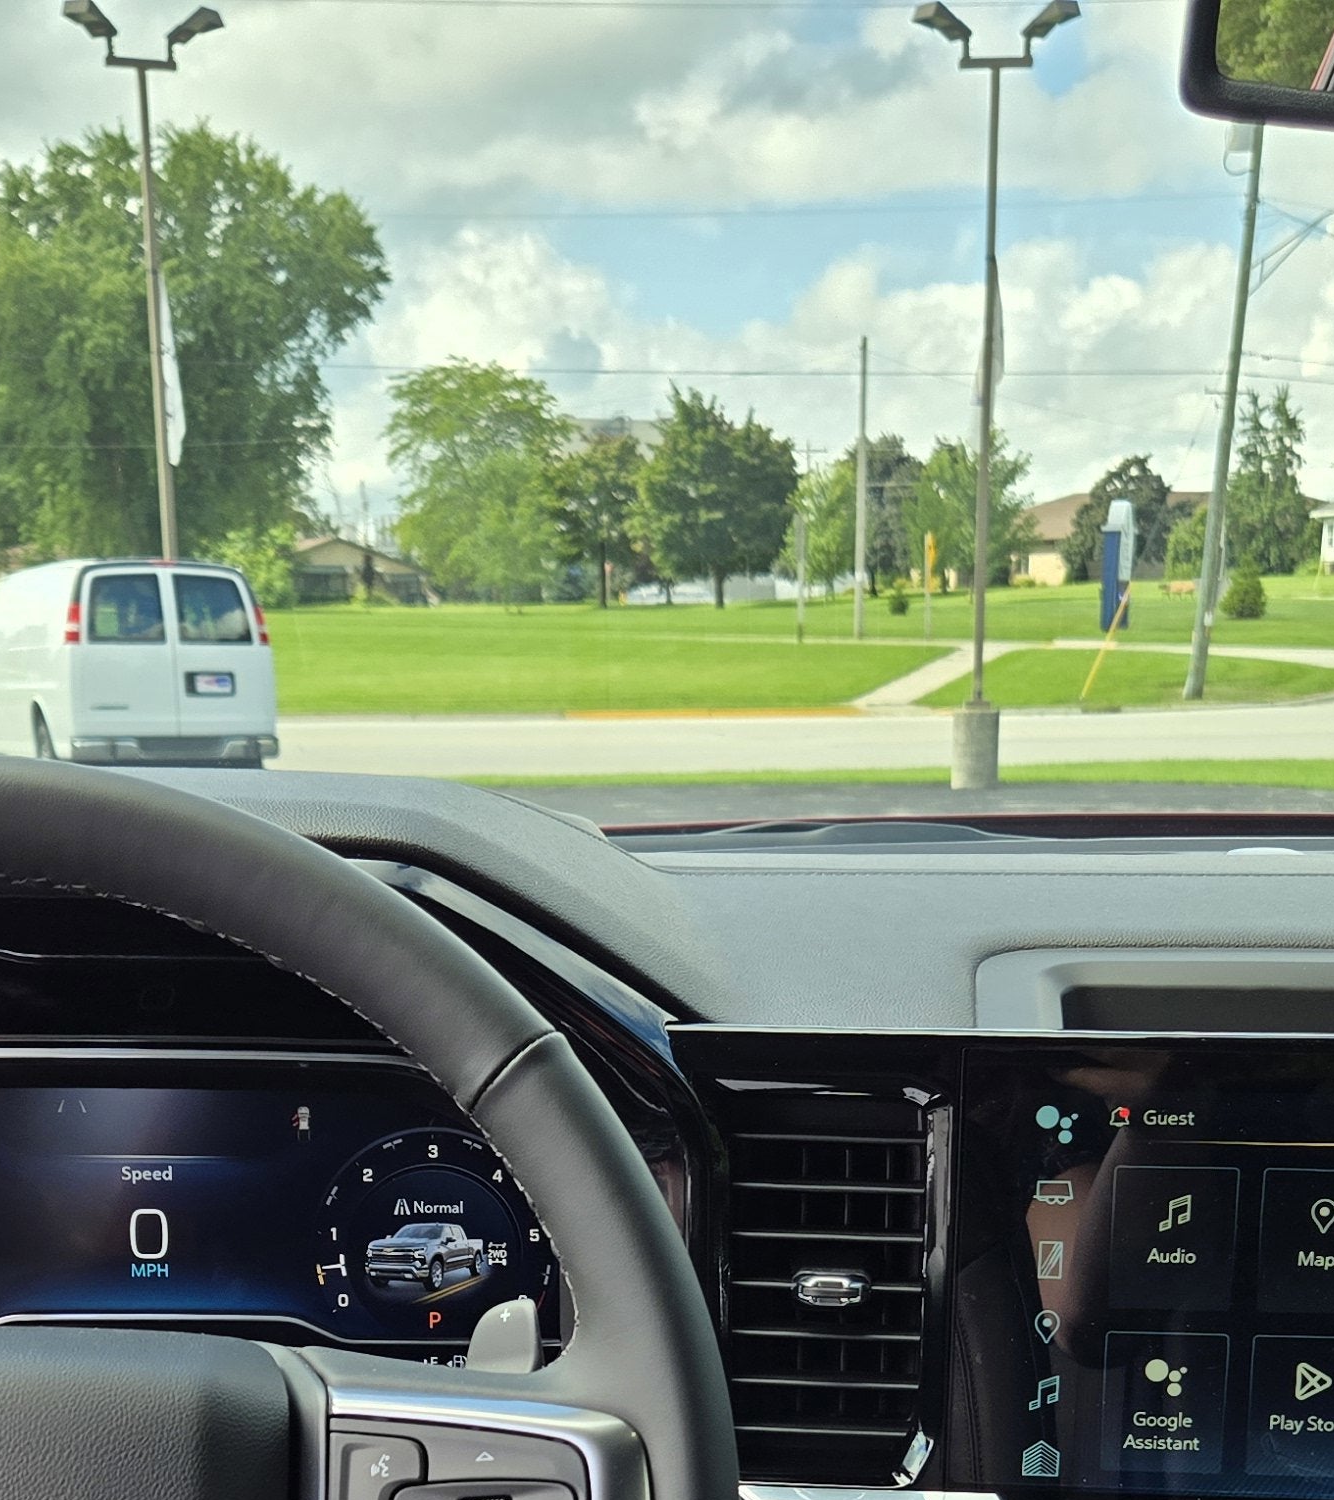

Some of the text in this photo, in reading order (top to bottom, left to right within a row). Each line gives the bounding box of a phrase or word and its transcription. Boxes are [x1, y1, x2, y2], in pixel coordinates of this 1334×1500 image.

[1144, 1110, 1194, 1125] Guest
[428, 1145, 438, 1158] 3
[122, 1166, 172, 1184] Speed
[363, 1169, 373, 1181] 2
[493, 1170, 502, 1182] 4
[414, 1201, 463, 1213] Normal
[129, 1208, 169, 1260] 0
[530, 1229, 539, 1241] 5
[488, 1250, 507, 1258] 2WD
[1147, 1248, 1196, 1263] Audio
[132, 1264, 168, 1277] MPH
[338, 1294, 348, 1307] 0
[430, 1312, 441, 1328] P
[1133, 1413, 1192, 1433] Google
[1270, 1415, 1304, 1434] Play
[1123, 1433, 1199, 1450] Assistant
